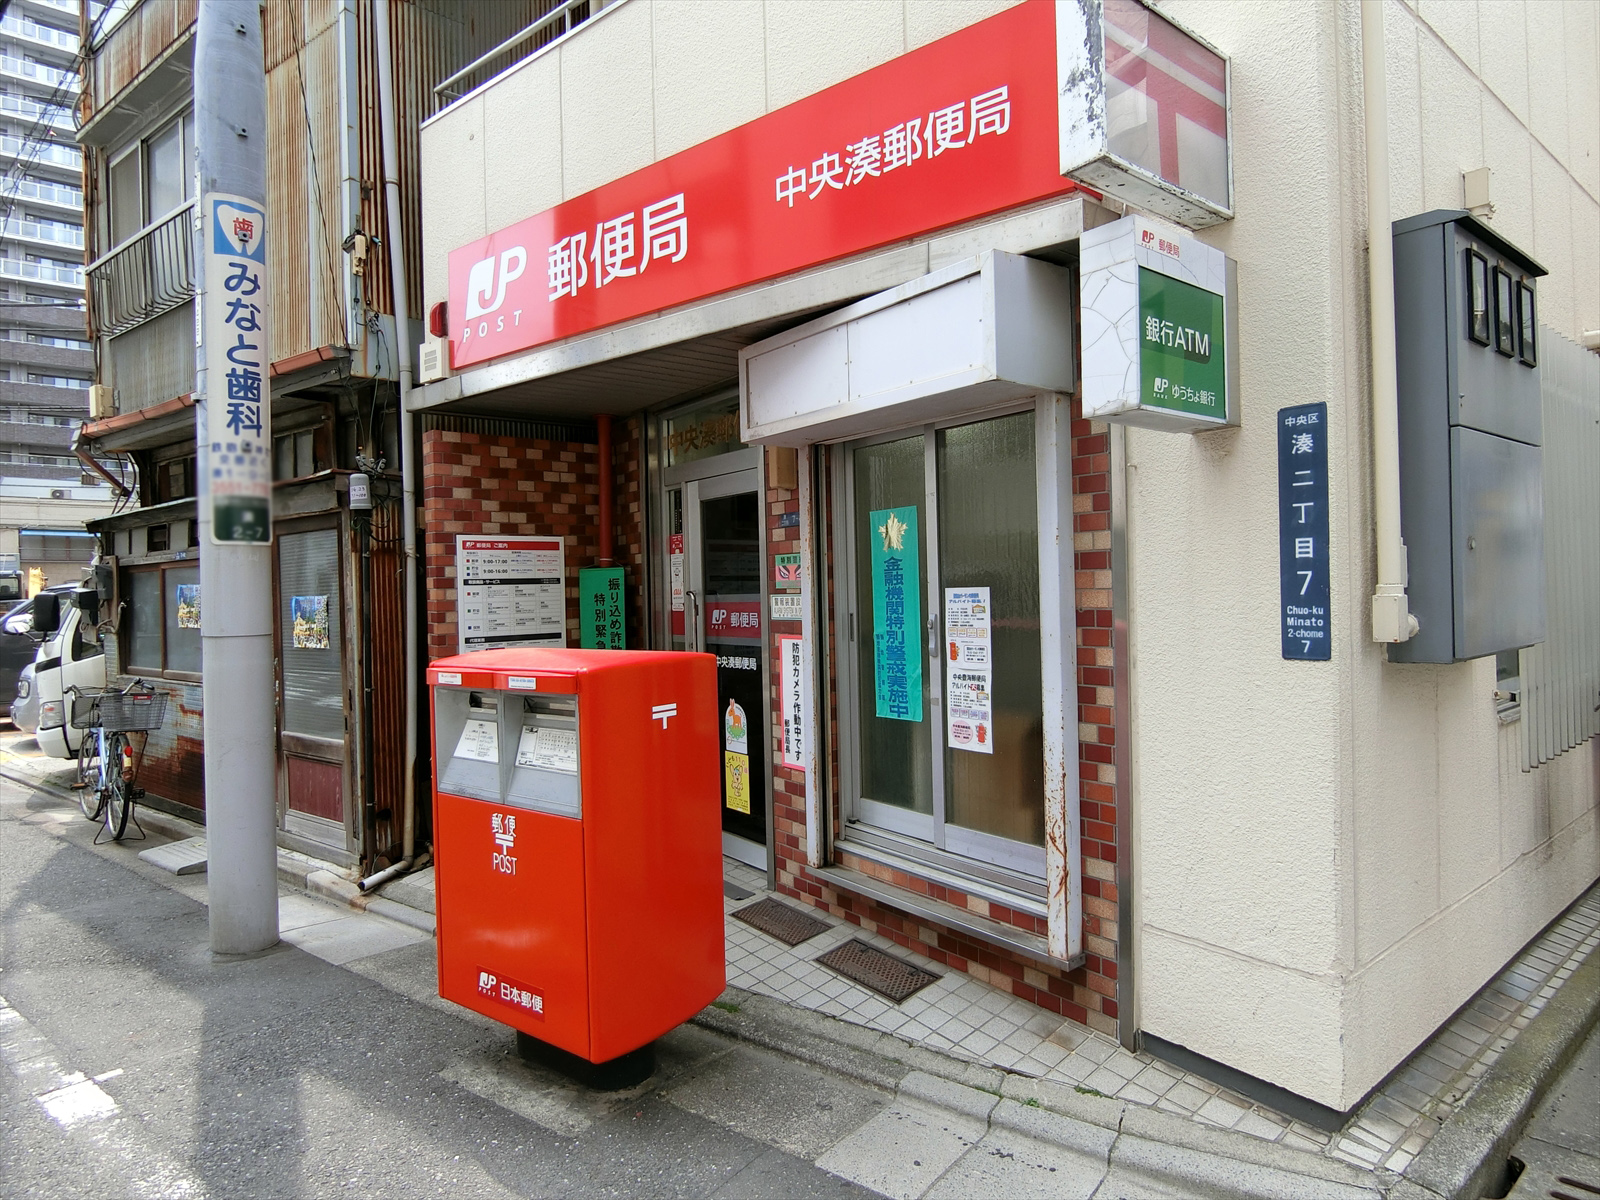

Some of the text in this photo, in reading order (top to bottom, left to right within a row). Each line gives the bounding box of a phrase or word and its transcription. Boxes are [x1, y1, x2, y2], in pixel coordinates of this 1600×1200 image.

[776, 84, 1011, 208] 中央湊郵便局
[548, 192, 688, 302] 郵便局
[1159, 239, 1180, 258] 郵便局
[466, 246, 527, 321] JP
[462, 309, 523, 343] POST
[1145, 315, 1209, 356] 銀行ATM
[224, 261, 262, 438] みなと歯科
[1172, 384, 1215, 406] ゆうちょ銀行
[1284, 412, 1319, 426] 中央区
[608, 578, 623, 650] 振り込め詐
[731, 612, 759, 628] 郵便局
[1287, 605, 1324, 614] Chuo-ku
[1287, 617, 1324, 626] Minato
[884, 556, 908, 718] 金融機関特別警戒実施中
[1287, 629, 1324, 638] 2-chome
[1301, 640, 1310, 653] 7
[792, 642, 802, 761] 防犯カメラ作動中です
[492, 812, 517, 837] 郵便
[493, 852, 518, 875] POST
[501, 982, 543, 1014] 日本郵便
